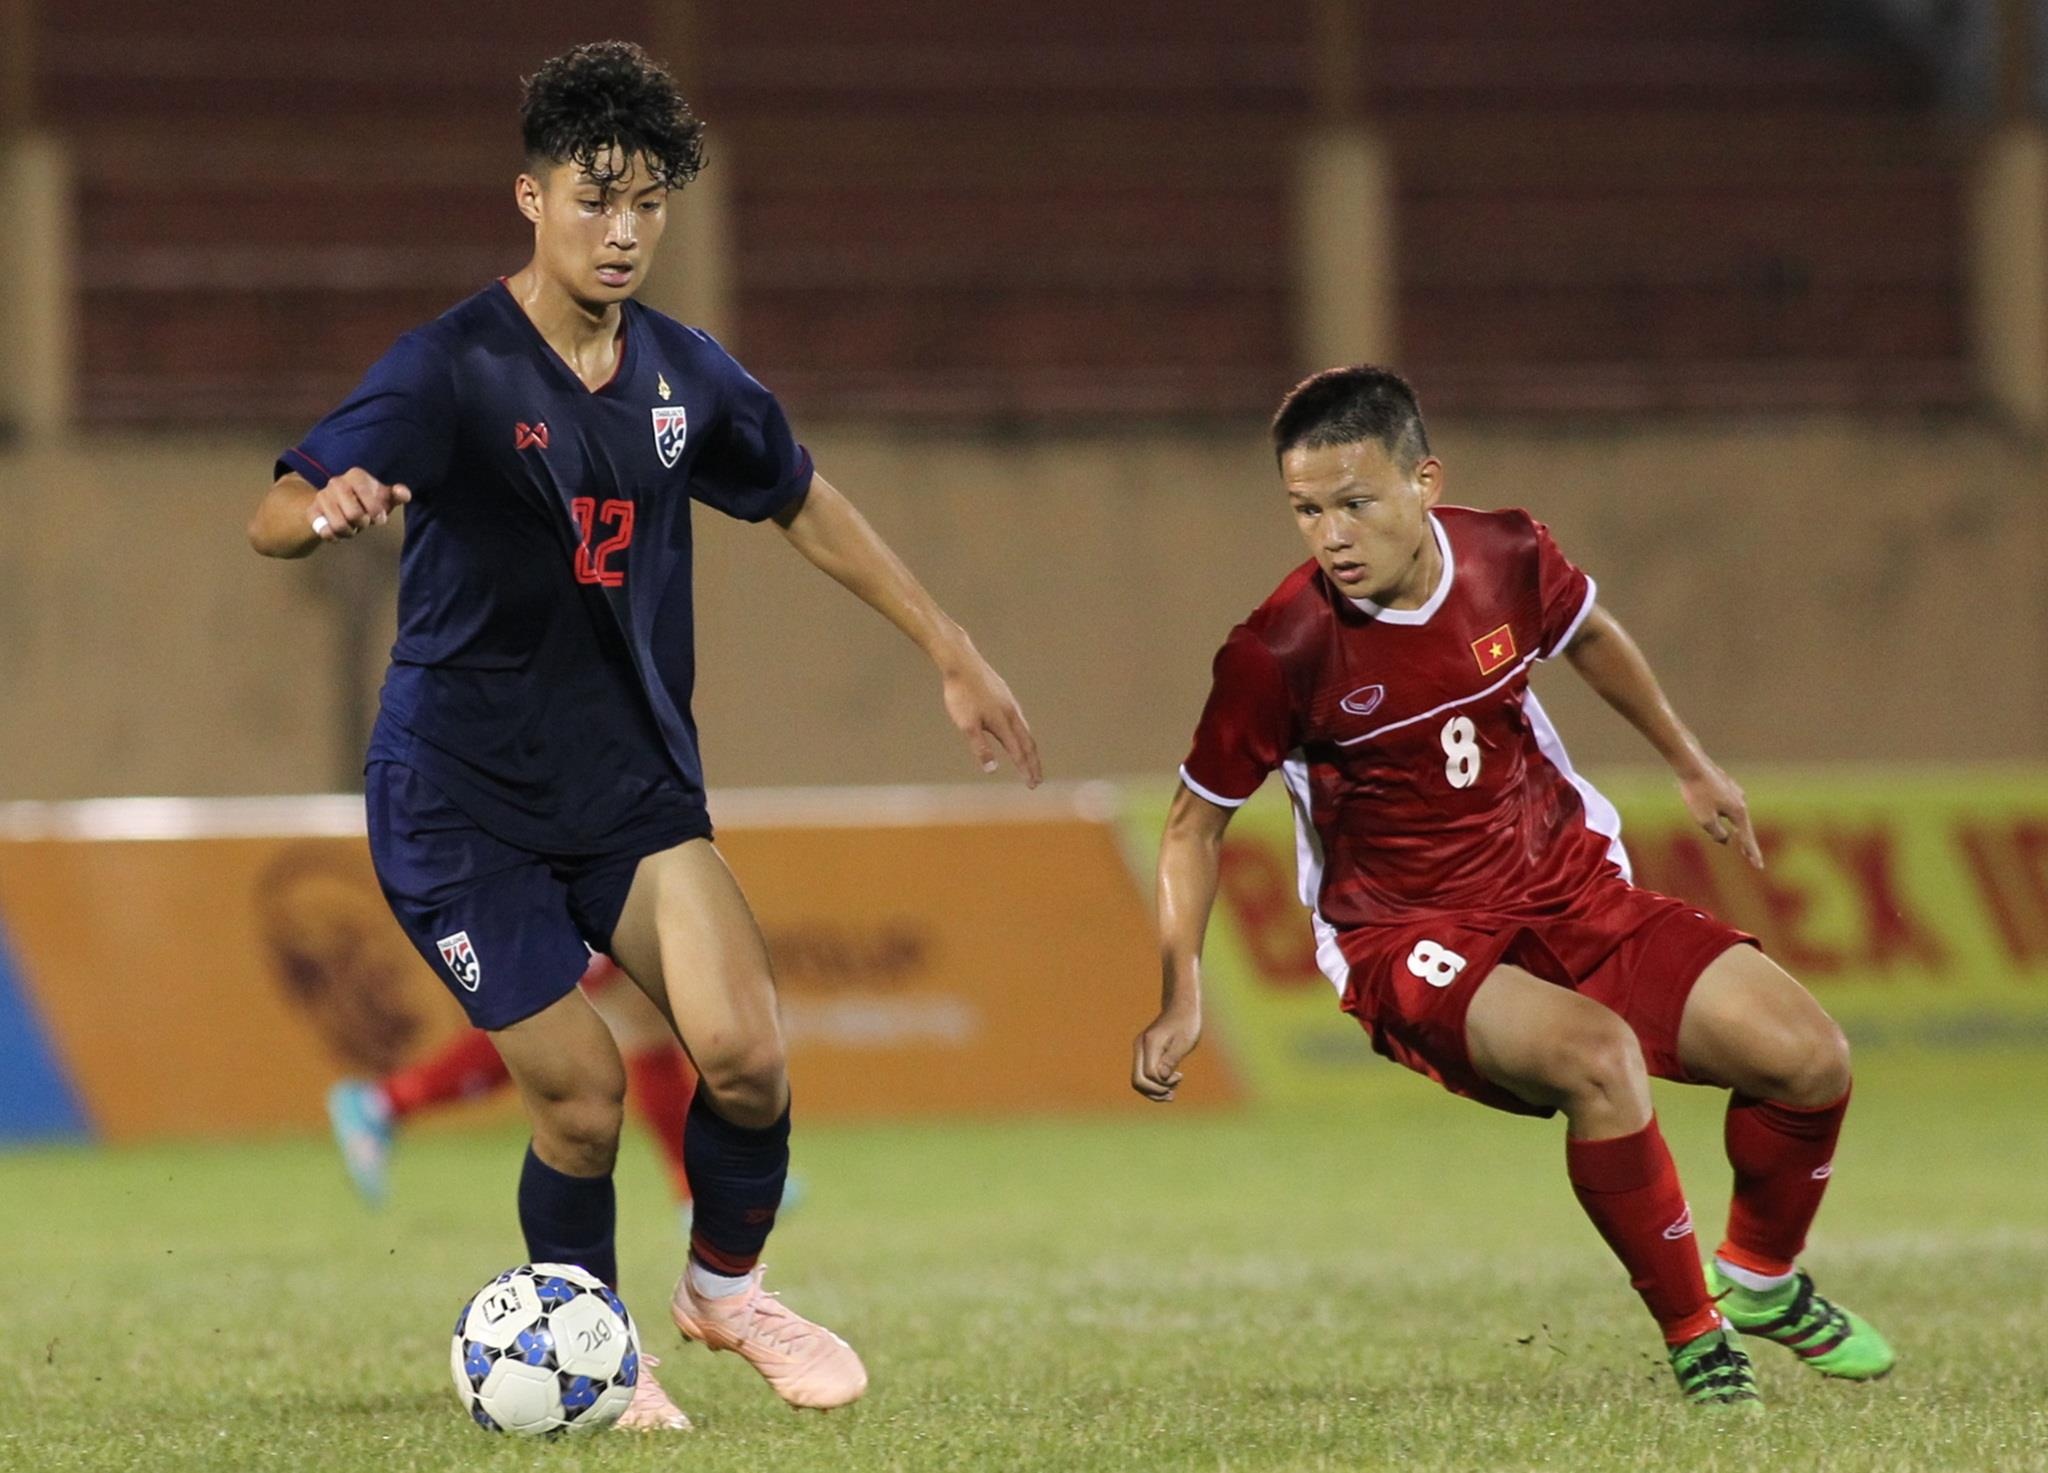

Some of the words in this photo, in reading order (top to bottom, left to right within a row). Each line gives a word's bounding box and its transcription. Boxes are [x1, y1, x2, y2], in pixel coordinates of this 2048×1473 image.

[570, 496, 635, 587] 12
[1440, 715, 1481, 789] 8
[1406, 939, 1467, 988] 8
